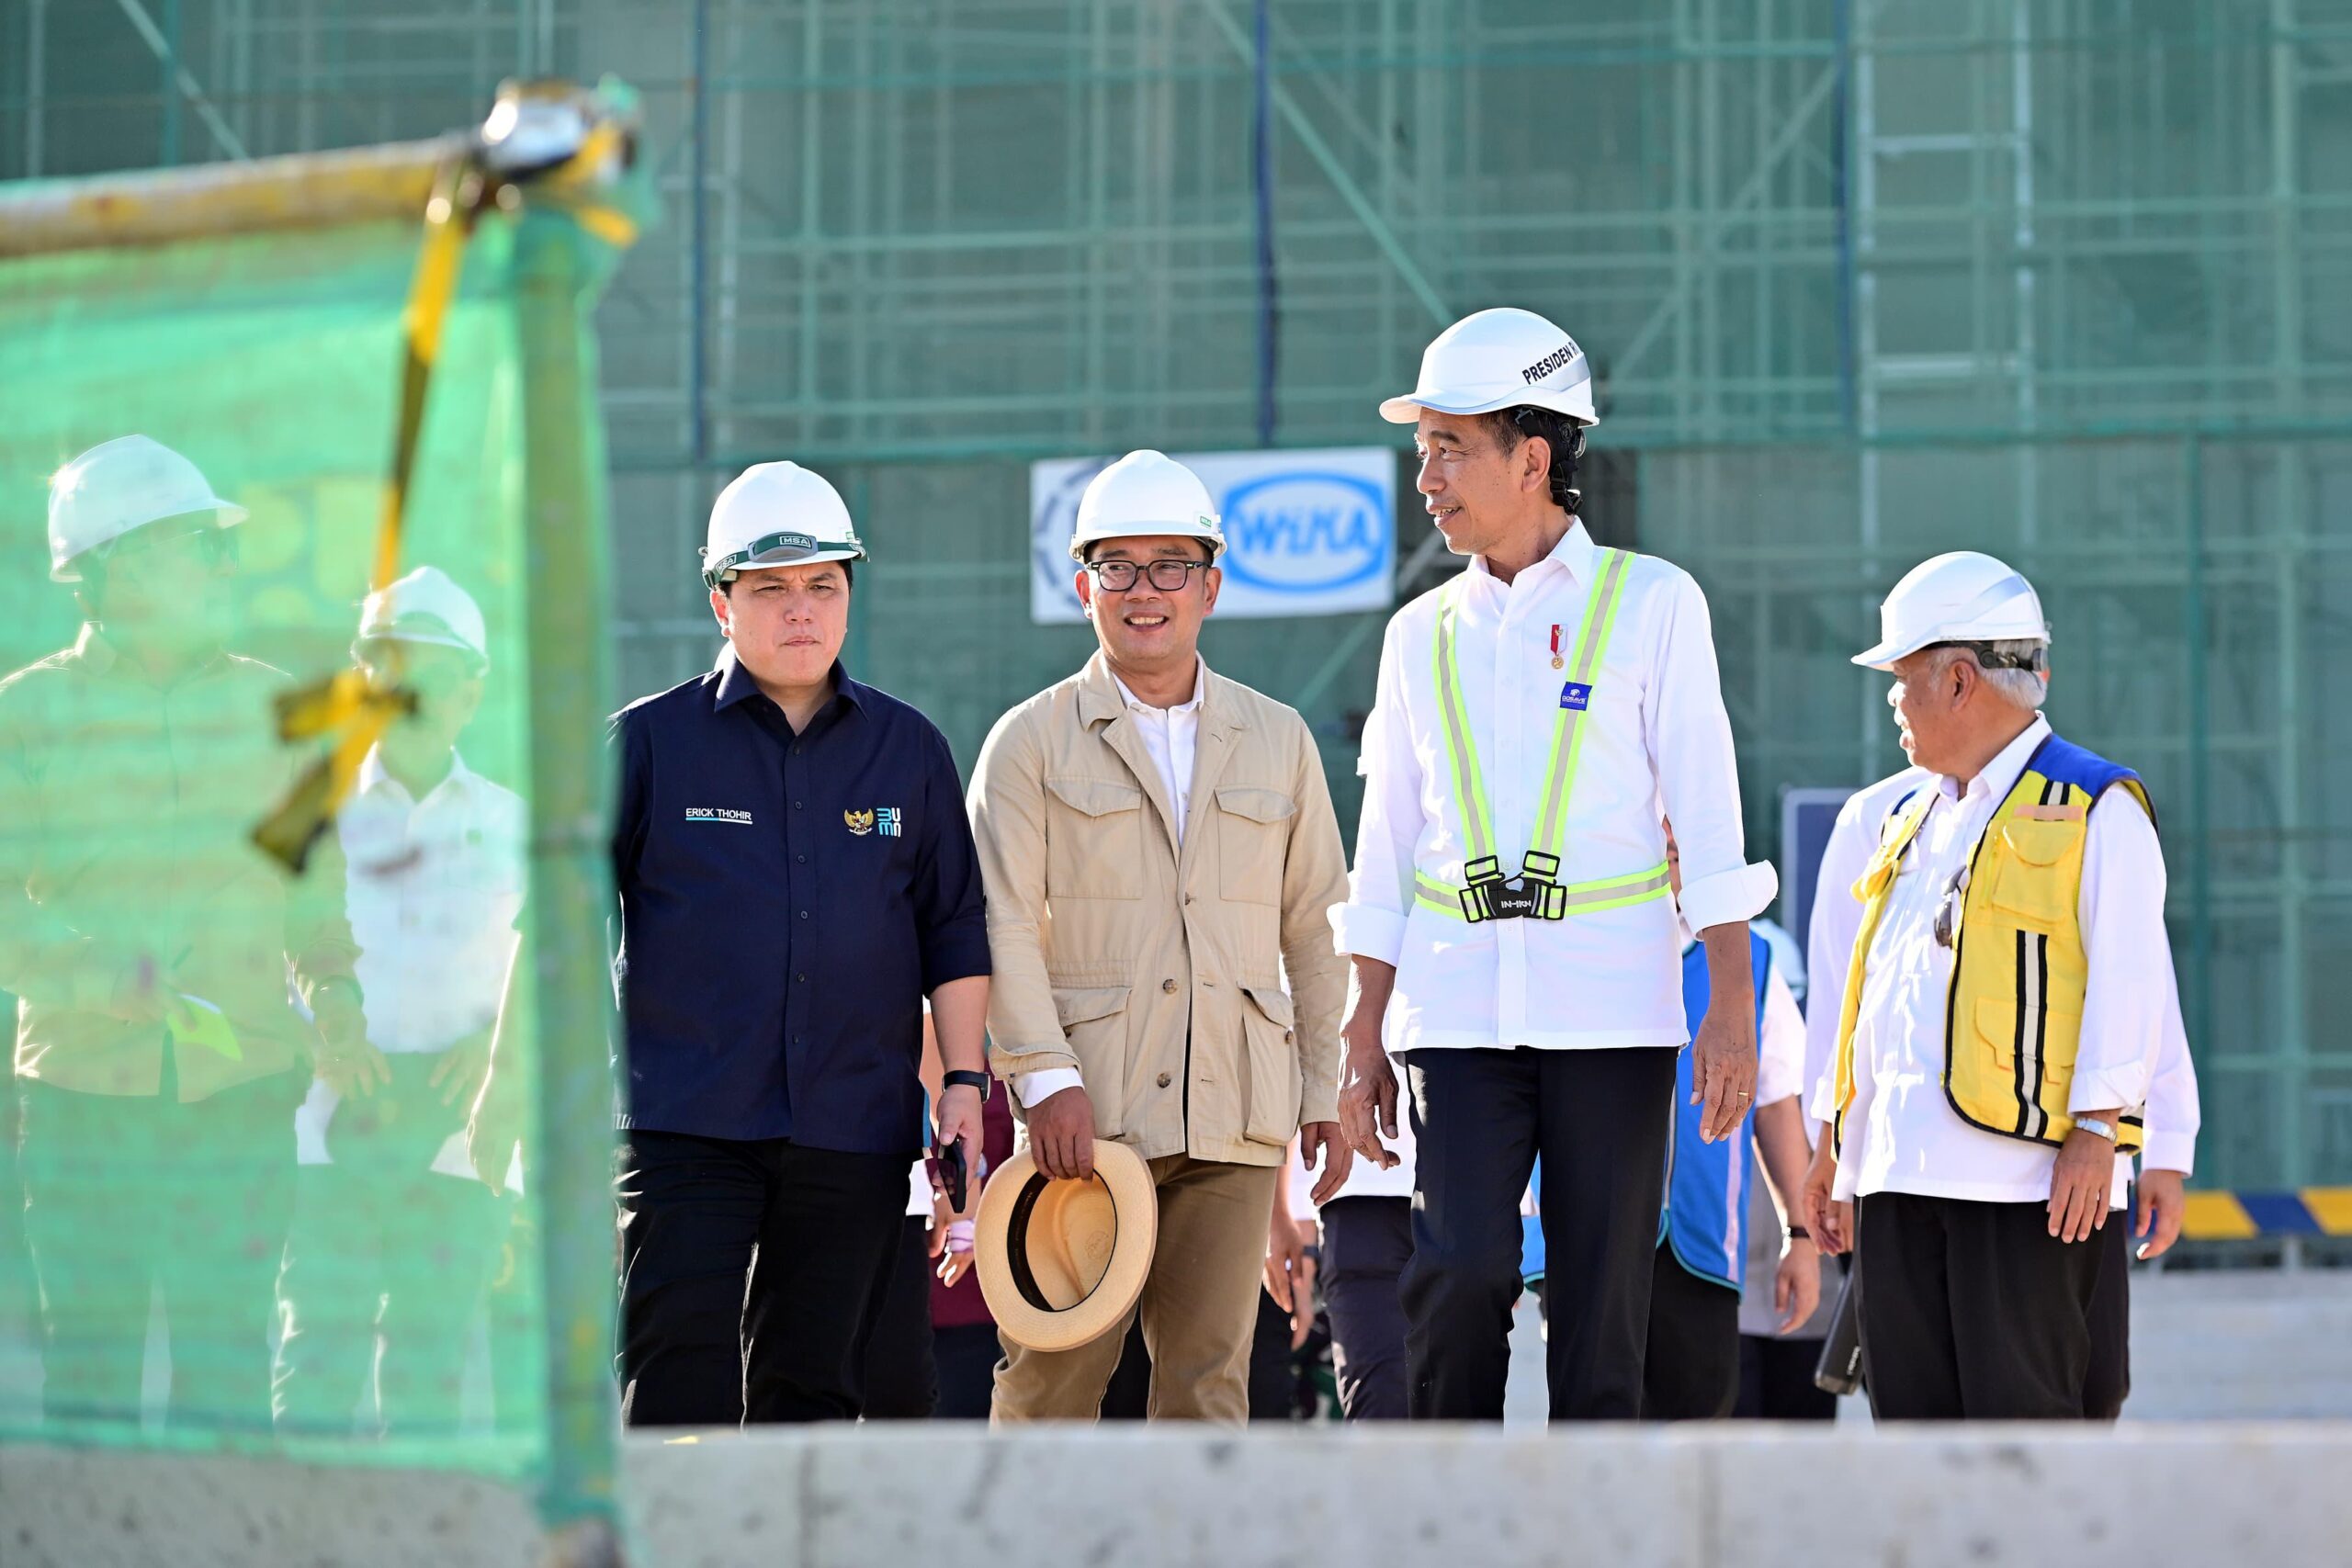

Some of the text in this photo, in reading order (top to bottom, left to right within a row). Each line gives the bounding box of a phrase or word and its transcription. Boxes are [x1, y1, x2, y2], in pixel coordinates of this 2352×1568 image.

[1521, 344, 1574, 385] PRESIDEN
[783, 536, 809, 547] MSA
[685, 807, 752, 820] ERICK THOHIR
